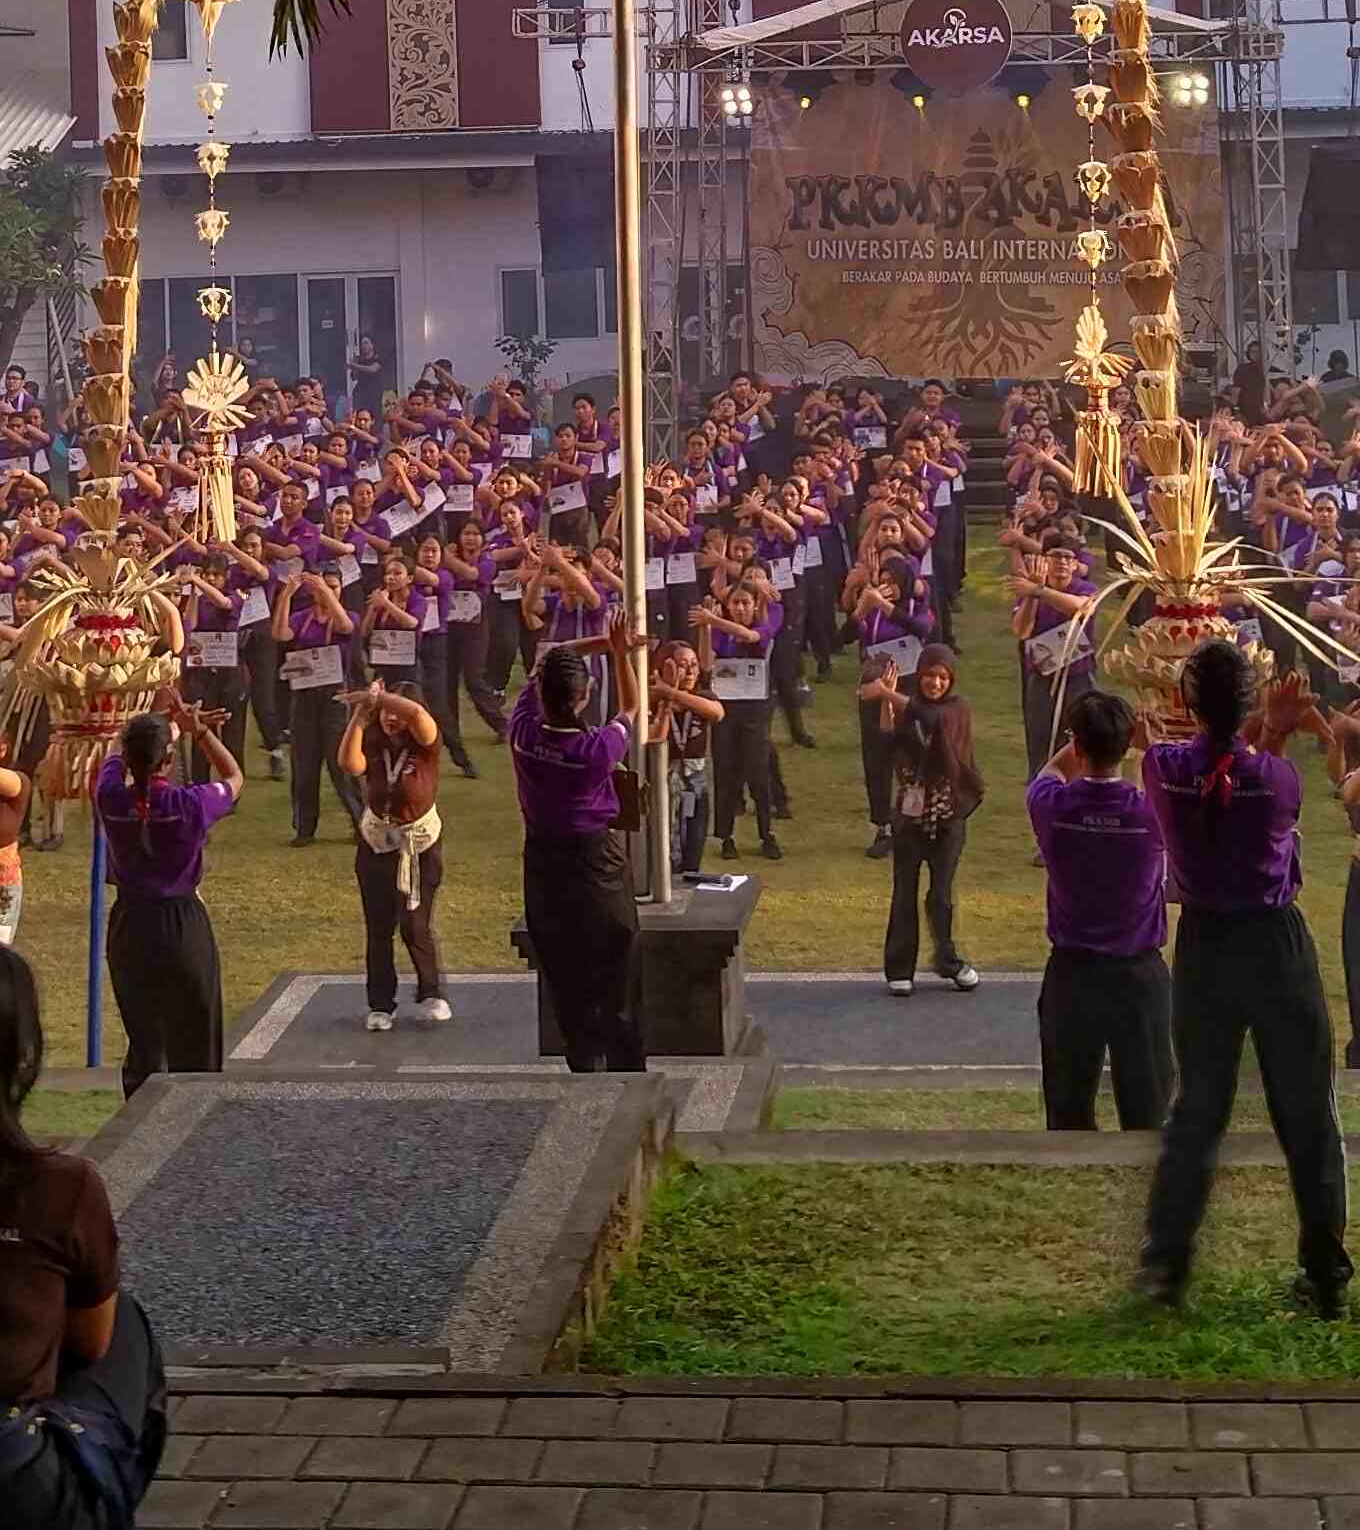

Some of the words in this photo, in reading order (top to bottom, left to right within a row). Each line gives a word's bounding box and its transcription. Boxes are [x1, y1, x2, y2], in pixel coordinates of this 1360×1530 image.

[907, 26, 1005, 47] AKARSA
[785, 171, 964, 229] PKKMB
[807, 239, 935, 260] UNIVERSITAS
[943, 239, 984, 260] BALI
[842, 271, 892, 283] BERAKAR
[895, 271, 924, 283] PADA
[980, 271, 1045, 283] BERTUMBUH
